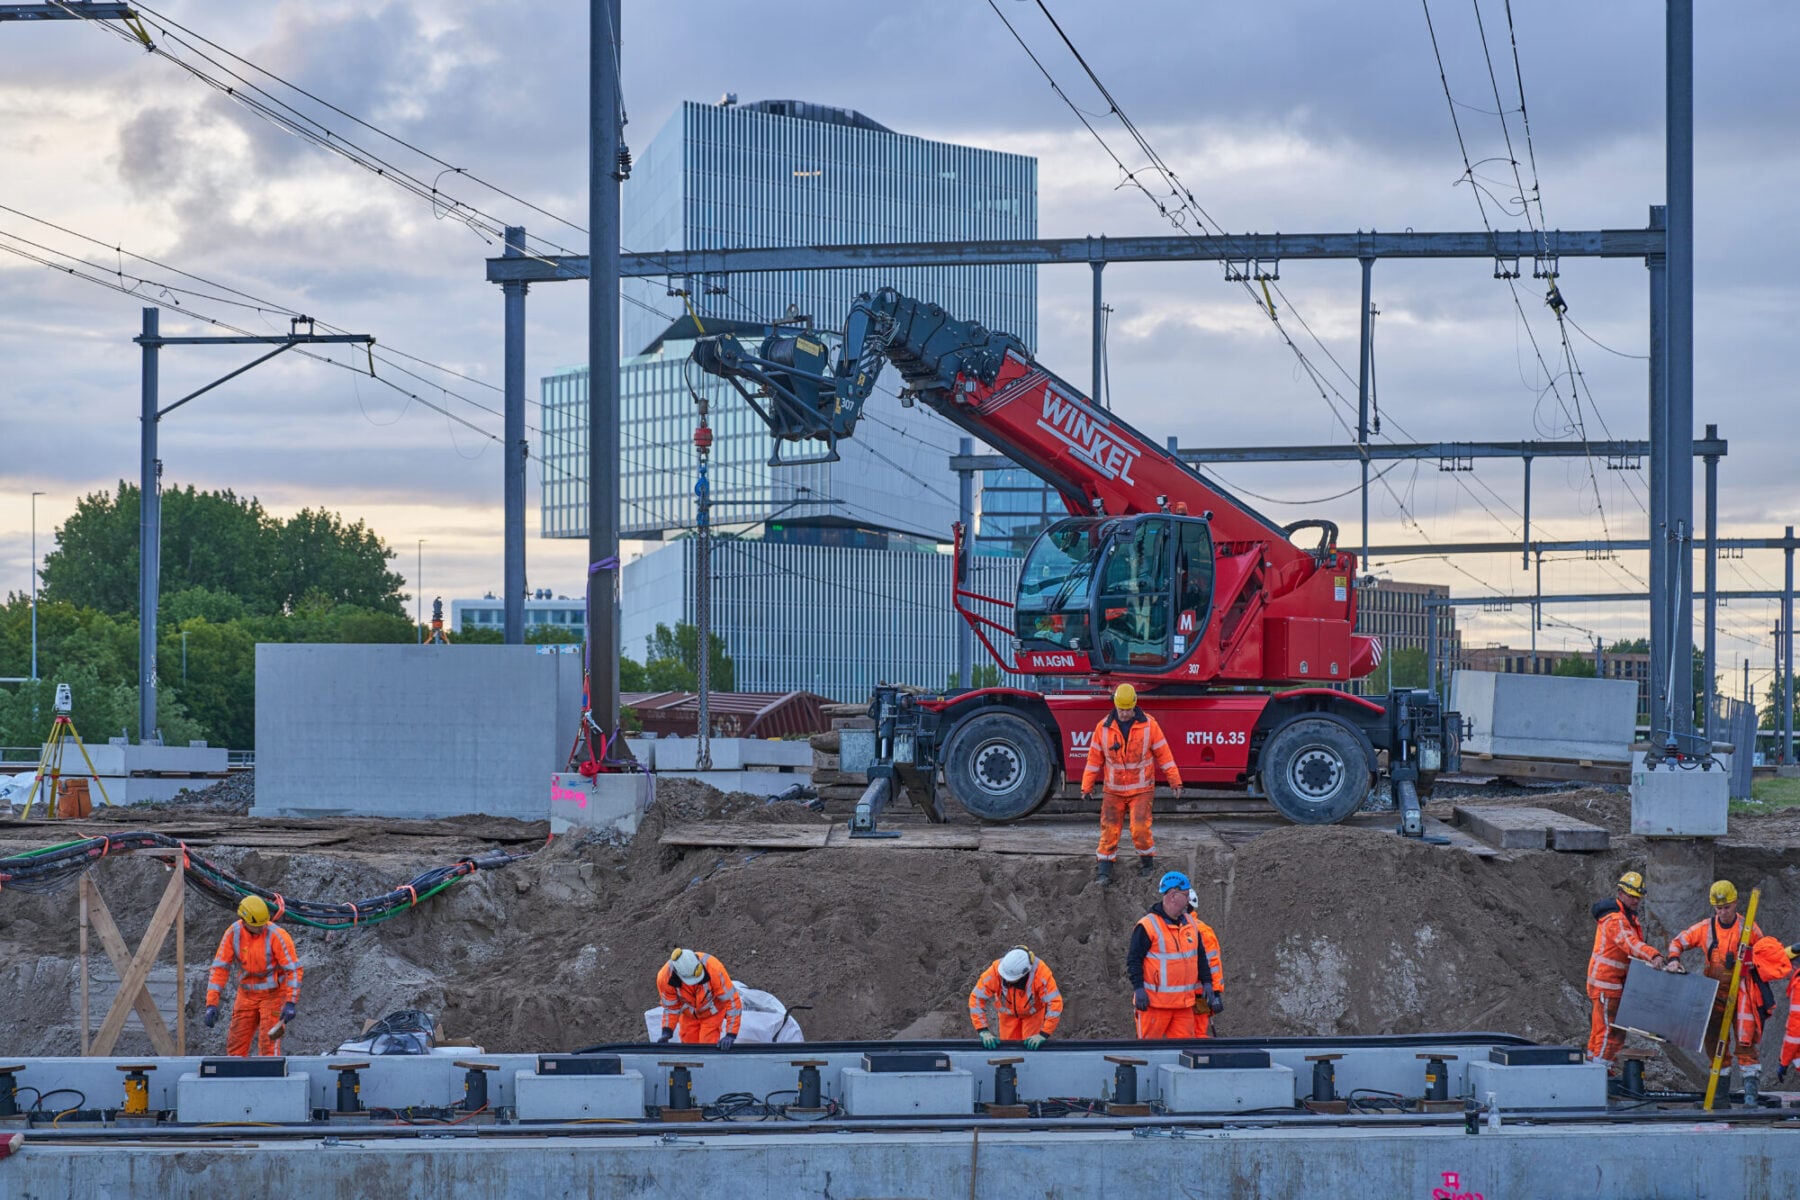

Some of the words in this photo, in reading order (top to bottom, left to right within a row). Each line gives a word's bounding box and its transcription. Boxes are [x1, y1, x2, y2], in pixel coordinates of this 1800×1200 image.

[841, 397, 854, 411] 307
[1042, 388, 1134, 487] WINKEL
[1180, 614, 1192, 631] M
[1032, 655, 1075, 667] MAGNI
[1188, 663, 1200, 674] 307
[1186, 731, 1213, 745] RTH
[1215, 731, 1246, 745] 6.35
